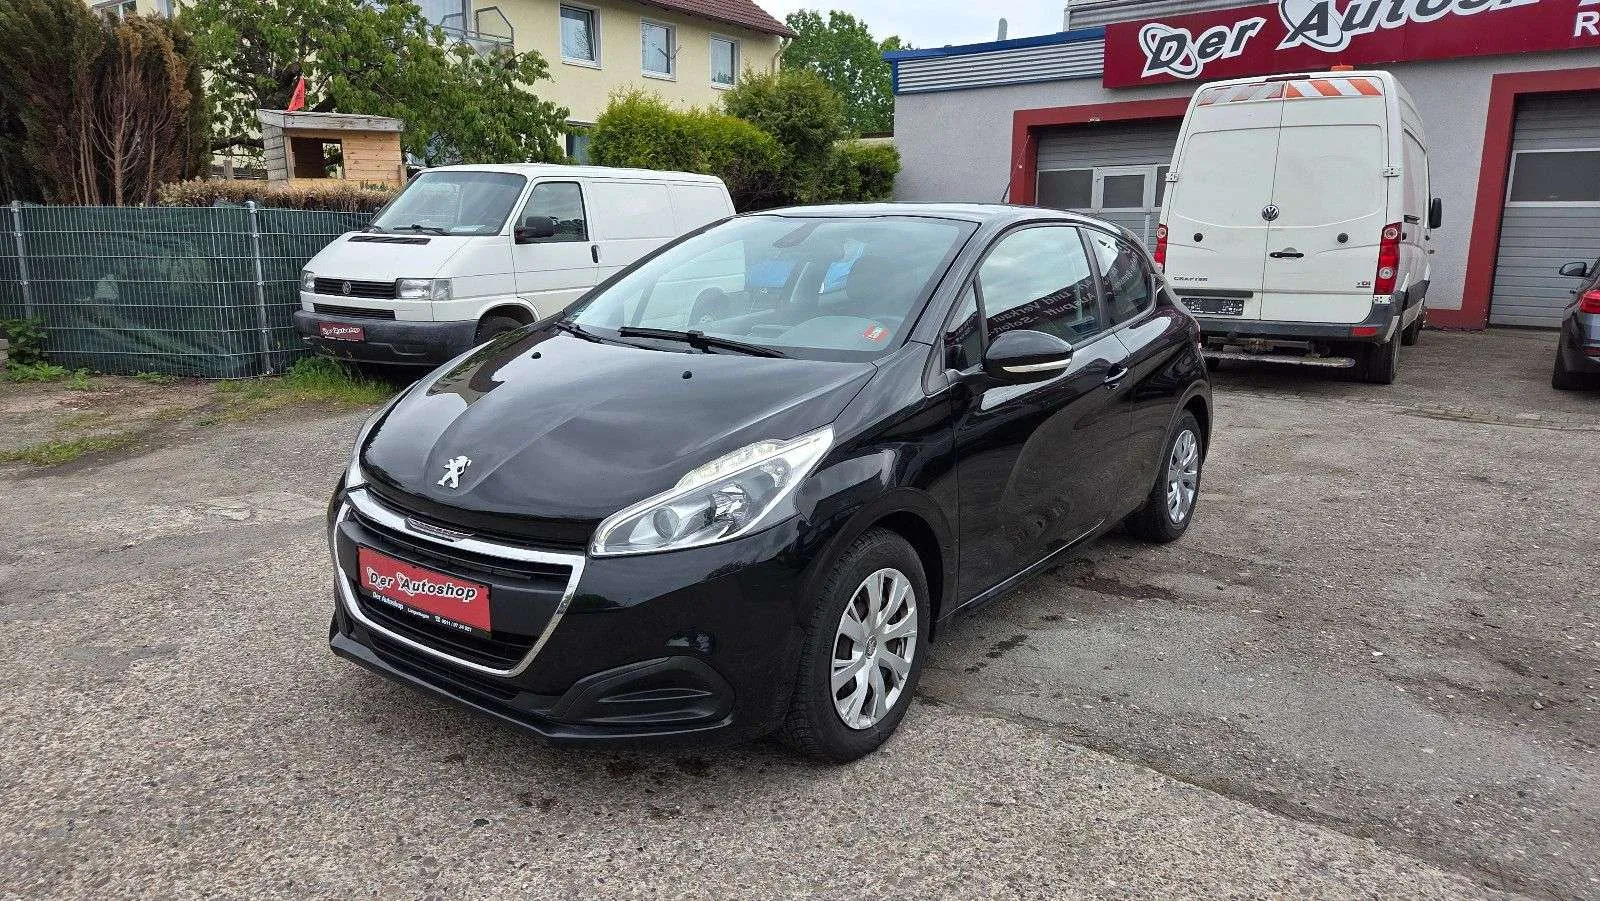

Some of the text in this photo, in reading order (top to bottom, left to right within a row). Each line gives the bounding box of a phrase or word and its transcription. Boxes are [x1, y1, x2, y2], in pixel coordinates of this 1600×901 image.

[1142, 0, 1532, 78] Der Auto
[367, 567, 478, 602] Der Autoshop
